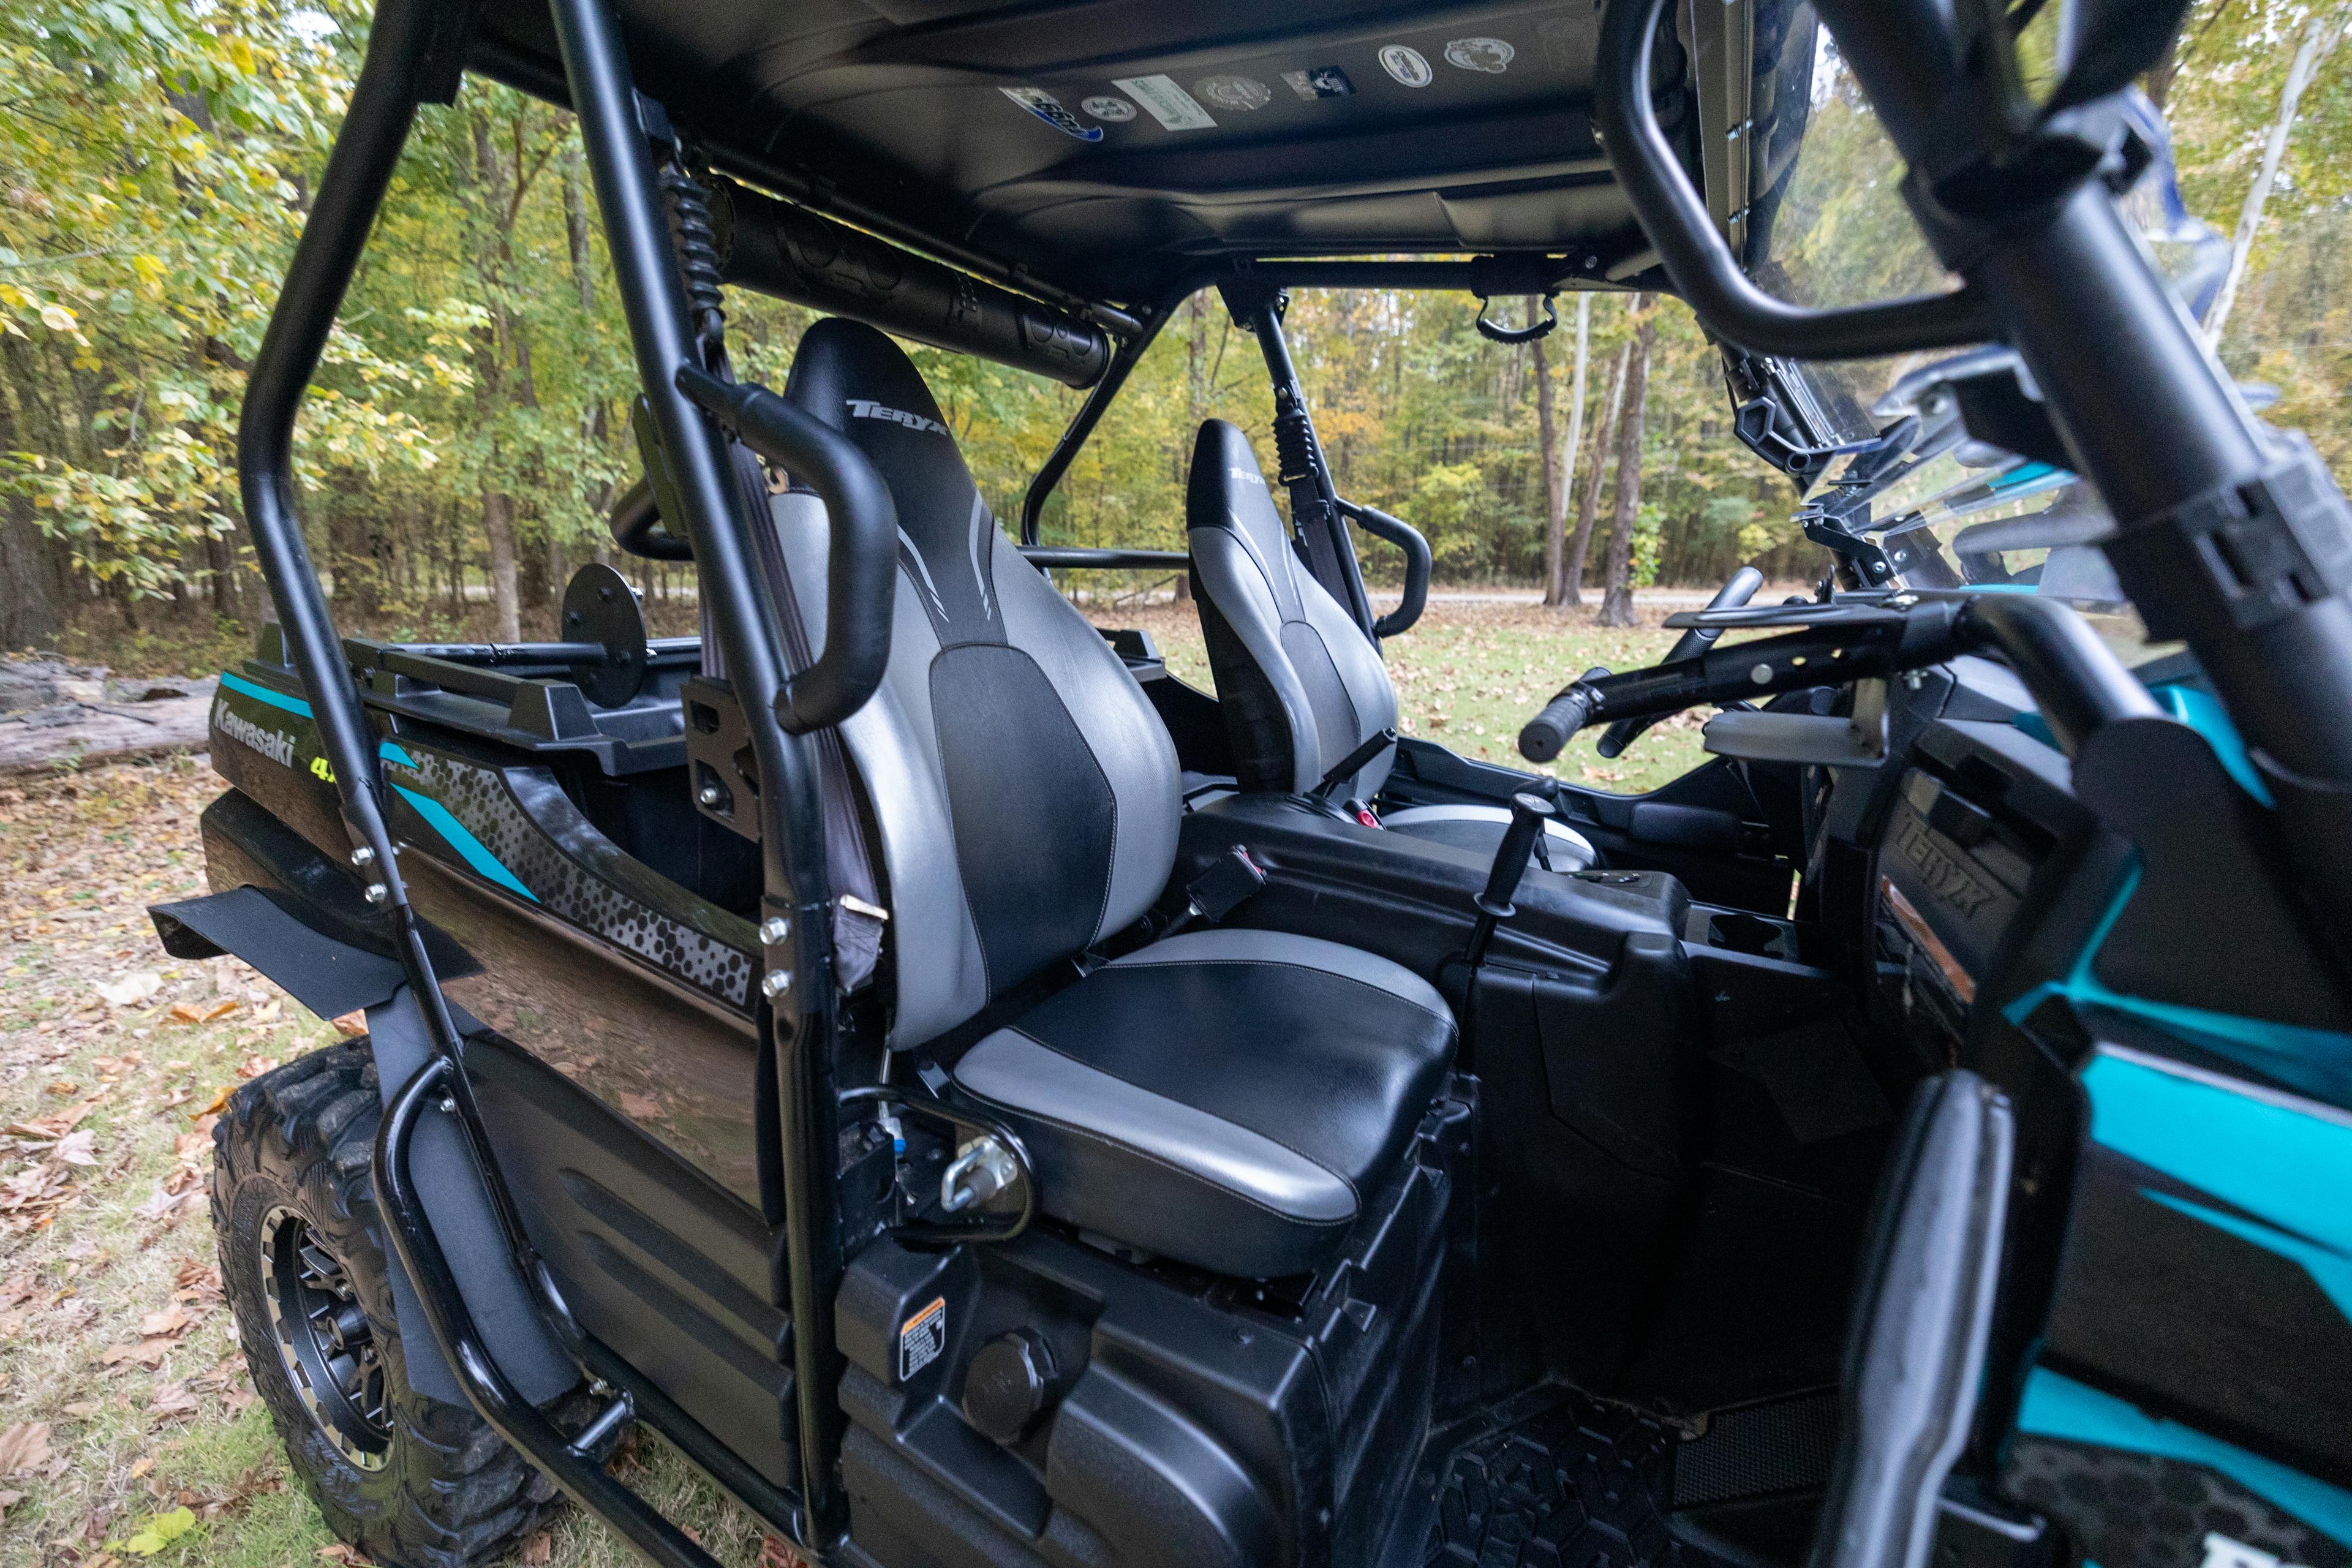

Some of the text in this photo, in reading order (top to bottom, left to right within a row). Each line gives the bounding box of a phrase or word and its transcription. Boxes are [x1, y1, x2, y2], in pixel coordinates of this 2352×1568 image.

[214, 698, 296, 769] Kawasaki
[311, 756, 336, 783] 4
[1894, 811, 1997, 920] TERYX
